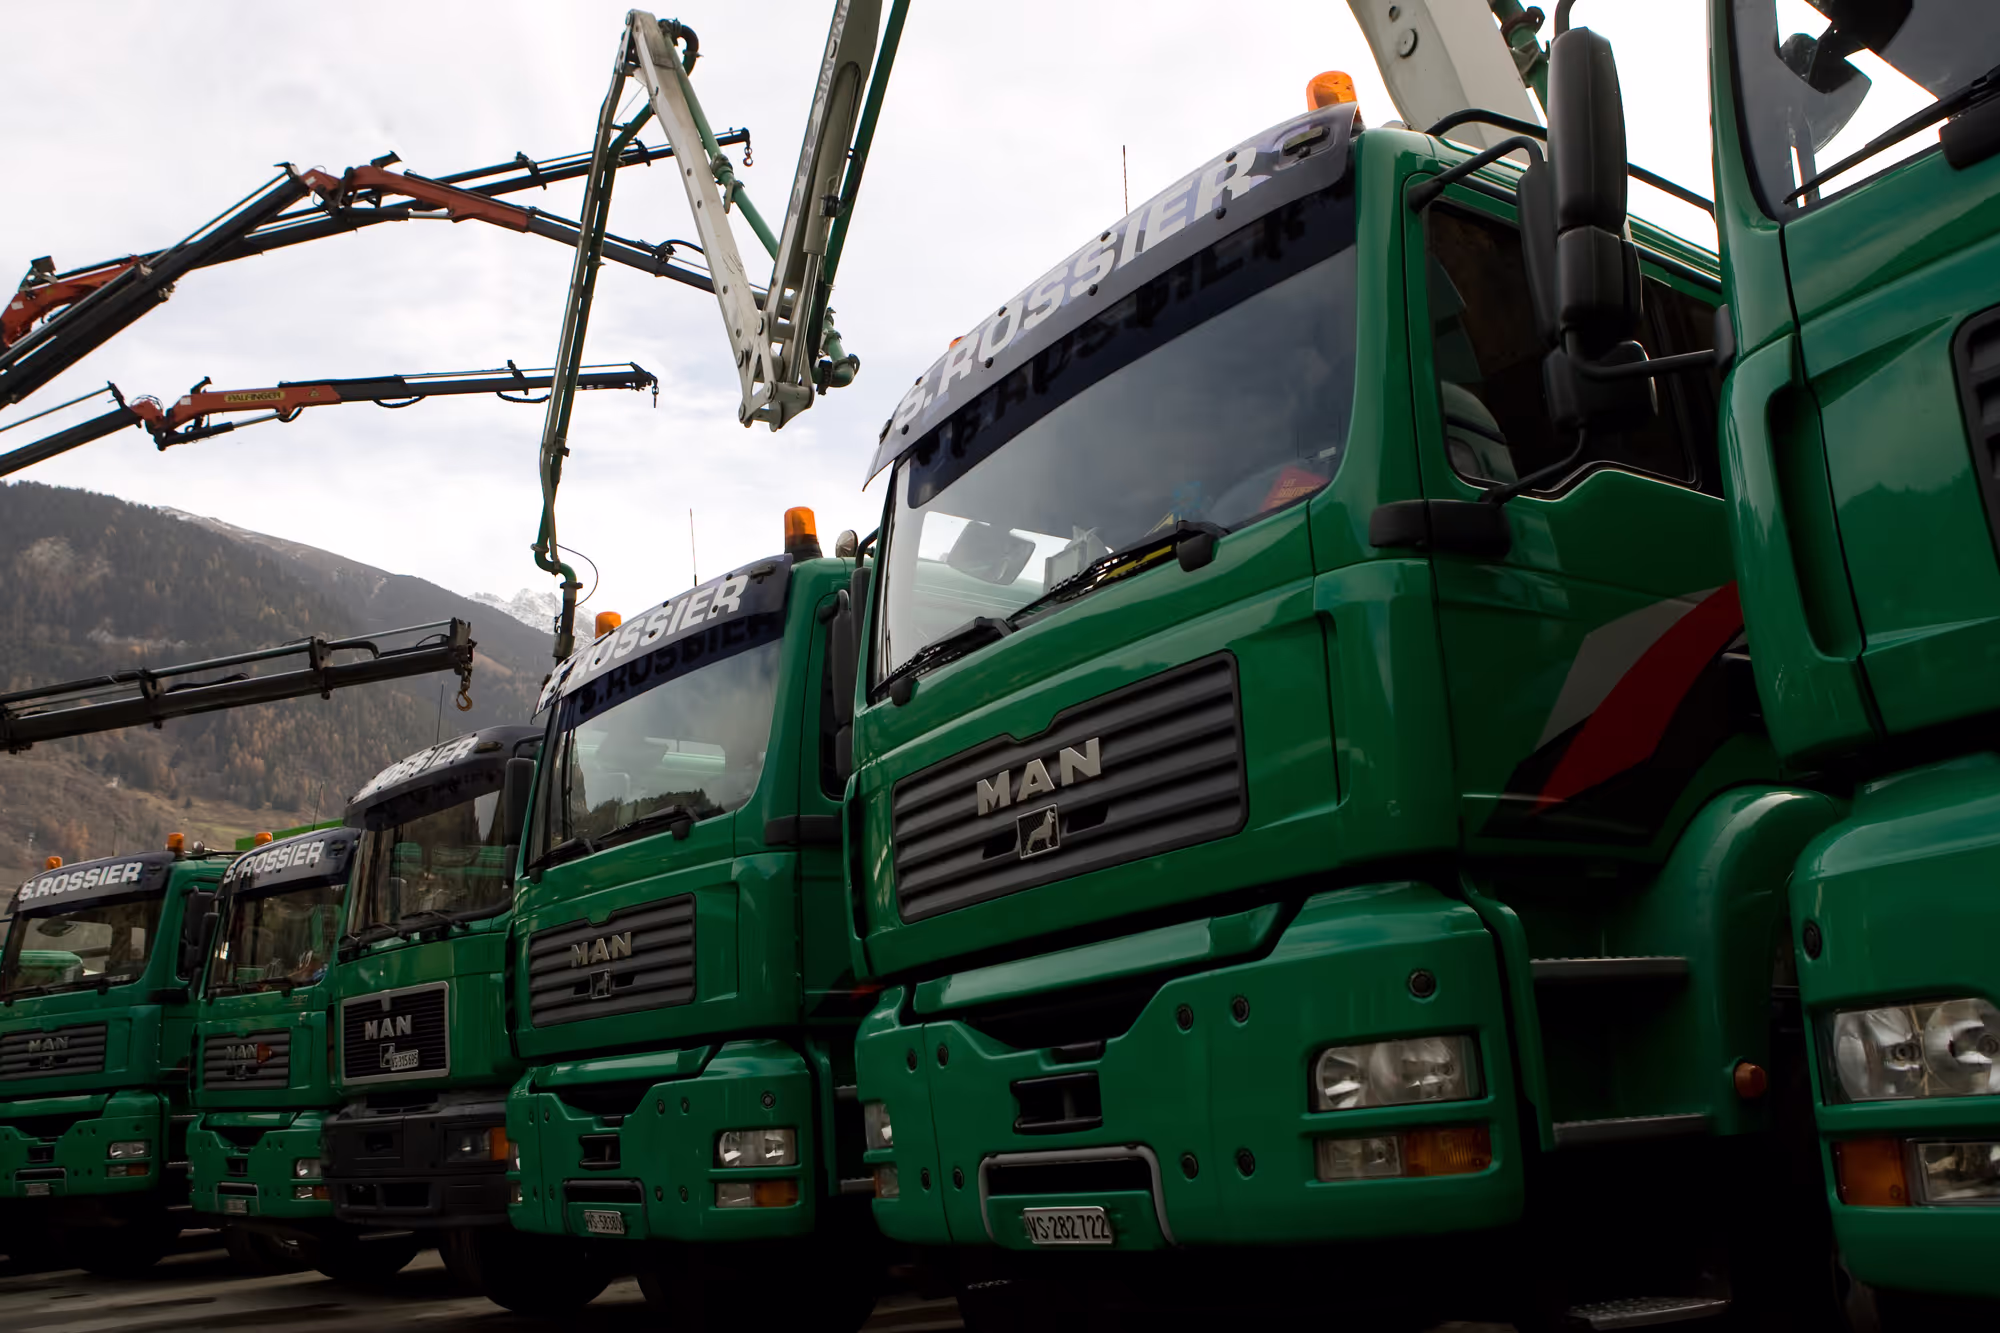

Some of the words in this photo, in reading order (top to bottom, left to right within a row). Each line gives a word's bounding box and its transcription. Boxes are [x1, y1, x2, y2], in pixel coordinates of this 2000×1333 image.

[976, 737, 1101, 816] MAN
[18, 861, 143, 901] S.ROSSIER
[571, 931, 632, 968] MAN
[28, 1036, 69, 1055] MAN
[364, 1014, 412, 1040] MAN
